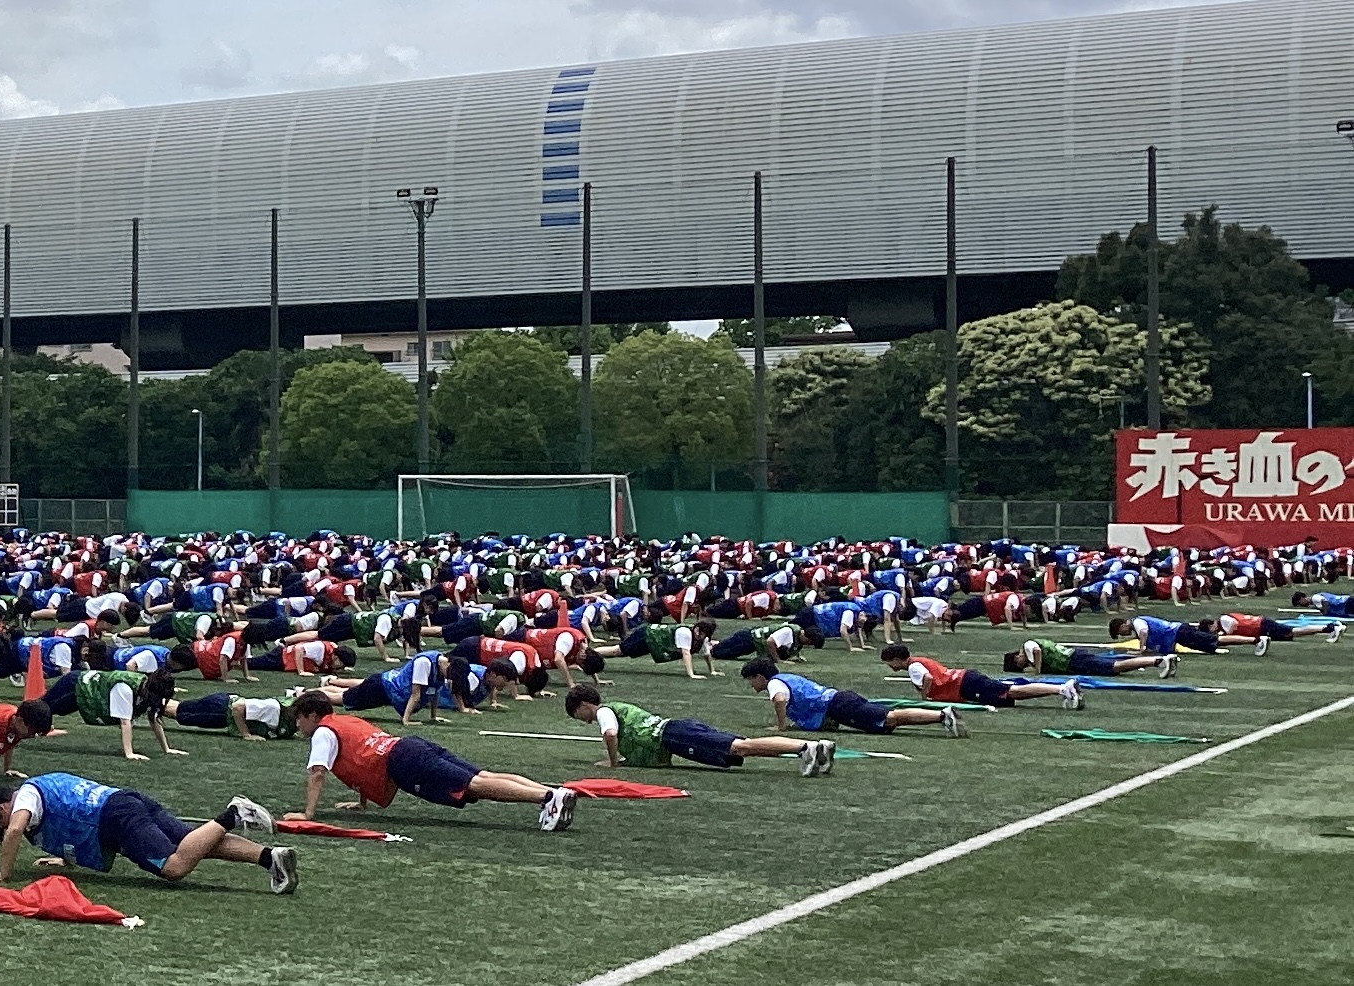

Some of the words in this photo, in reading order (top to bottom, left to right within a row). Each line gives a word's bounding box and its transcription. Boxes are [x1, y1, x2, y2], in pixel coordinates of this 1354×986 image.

[1125, 432, 1354, 502] 赤き血の
[1203, 502, 1312, 521] URAWA
